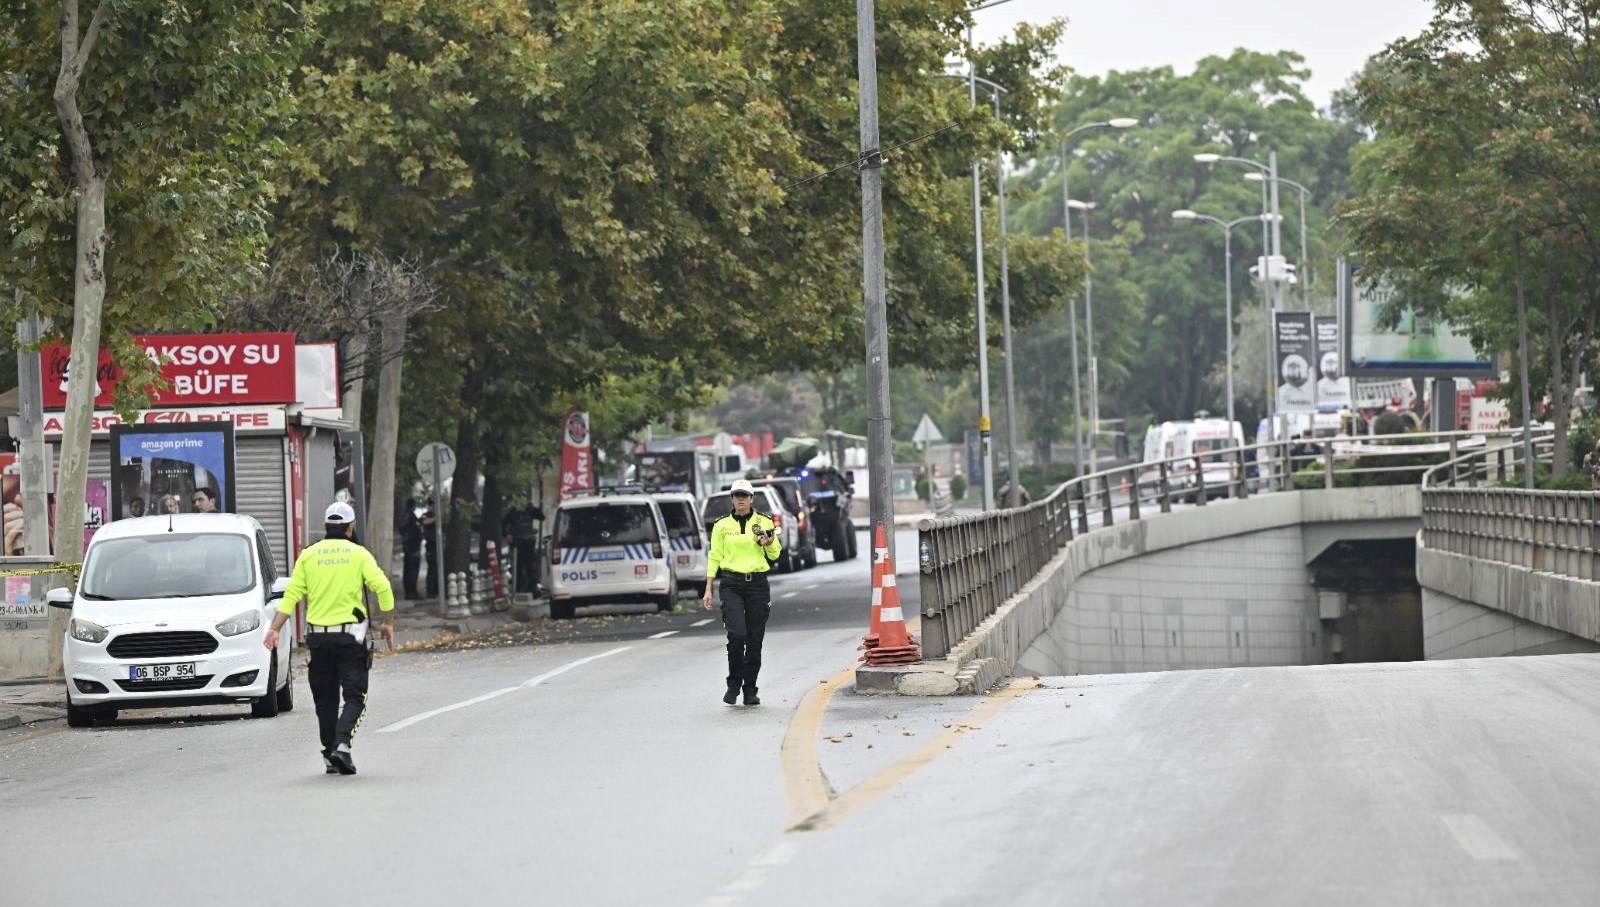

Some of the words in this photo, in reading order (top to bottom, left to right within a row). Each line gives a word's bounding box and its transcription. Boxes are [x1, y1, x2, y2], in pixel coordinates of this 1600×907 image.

[145, 345, 236, 366] AKSOY
[243, 344, 280, 364] SU
[174, 369, 249, 395] BÜFE
[141, 440, 174, 452] amazon
[174, 438, 204, 450] prime
[562, 570, 599, 582] POLIS
[136, 667, 148, 678] 06
[153, 665, 171, 677] BSP
[176, 664, 194, 675] 954
